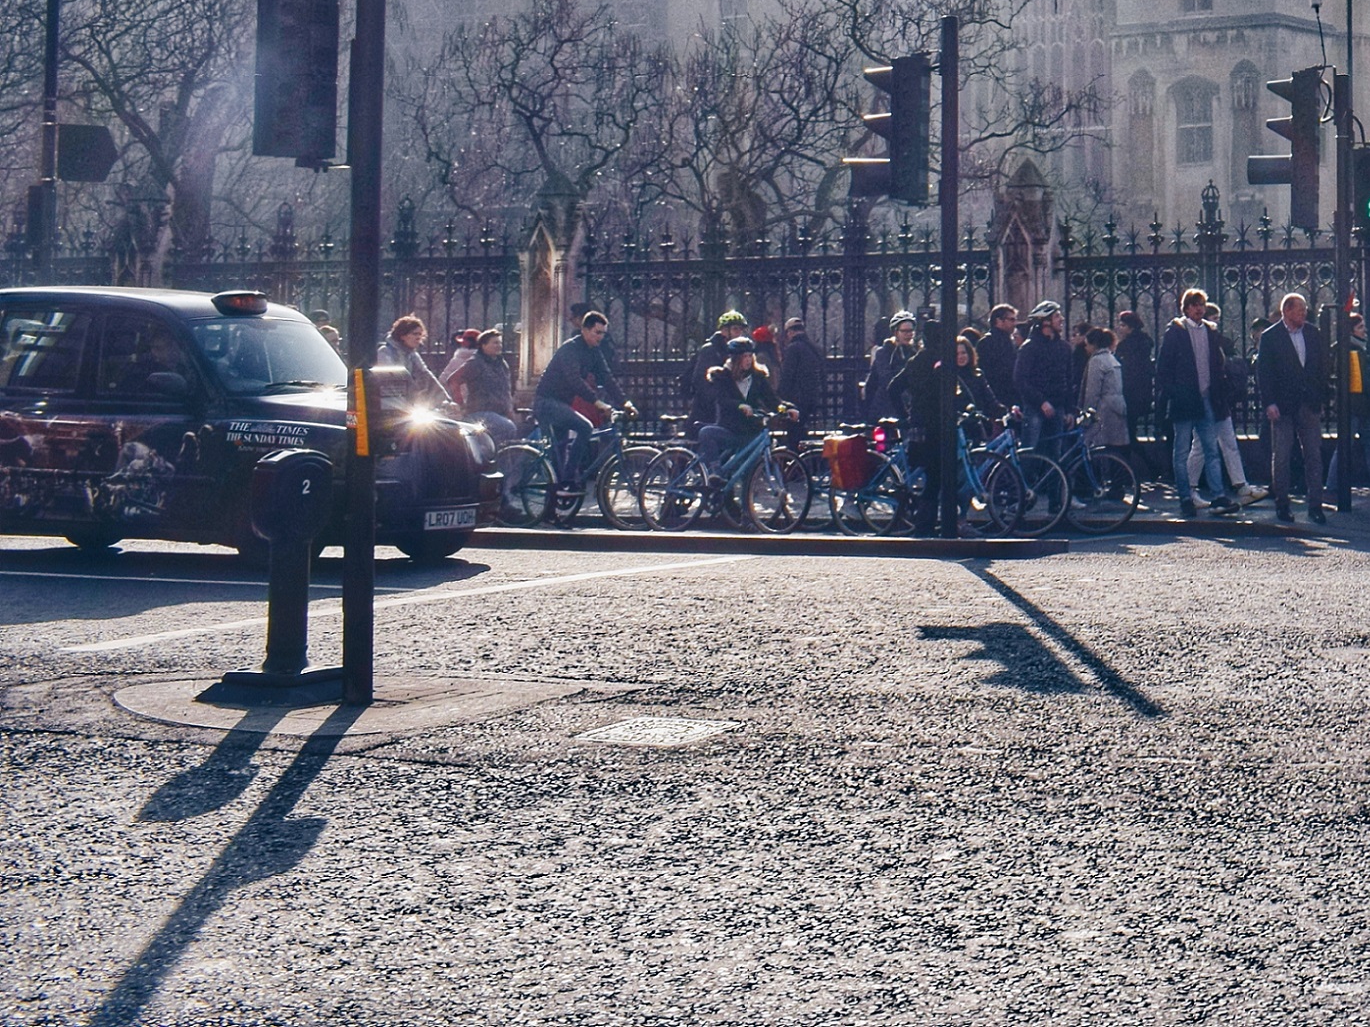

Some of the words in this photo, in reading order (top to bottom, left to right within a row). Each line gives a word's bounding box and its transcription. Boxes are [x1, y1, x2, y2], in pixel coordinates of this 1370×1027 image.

[229, 422, 251, 431] THE
[276, 425, 309, 435] TIMES
[226, 432, 243, 441] THE
[243, 434, 276, 444] SUNDAY
[278, 436, 304, 446] TIMES
[302, 479, 311, 494] 2
[429, 513, 455, 526] LR07
